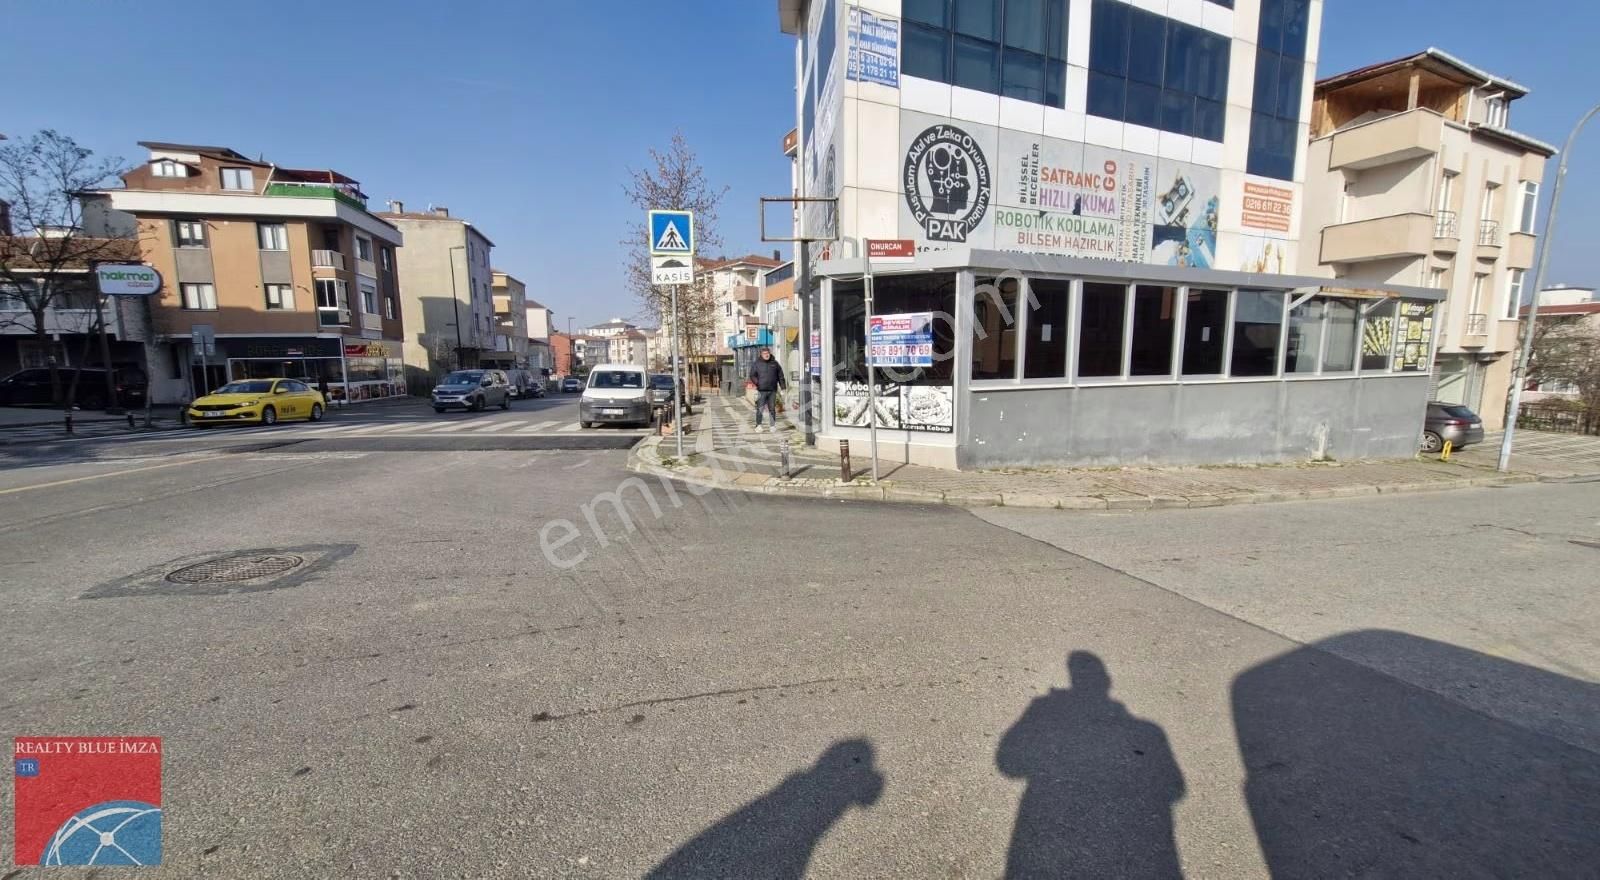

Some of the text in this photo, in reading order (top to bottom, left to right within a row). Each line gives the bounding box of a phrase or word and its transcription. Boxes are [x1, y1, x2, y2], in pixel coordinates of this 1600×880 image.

[879, 68, 888, 78] 21
[888, 70, 897, 80] 12
[924, 132, 937, 145] ve
[936, 126, 962, 142] Zeka
[962, 135, 987, 185] Oyunları
[1030, 143, 1040, 205] BECERİLER
[1041, 166, 1101, 193] SATRANÇ
[1102, 160, 1117, 192] GO
[907, 164, 926, 223] Pusulam
[1039, 187, 1071, 209] HIZLI
[967, 186, 990, 227] Kulübü
[1245, 198, 1262, 210] 0216
[929, 220, 965, 240] PAK
[1057, 217, 1115, 237] KODLAMA
[1017, 230, 1115, 252] BİLSEM HAZIRLIK
[656, 271, 690, 281] KASİS
[748, 328, 756, 337] E
[888, 345, 903, 355] 891
[905, 345, 916, 355] 70
[919, 344, 930, 355] 69
